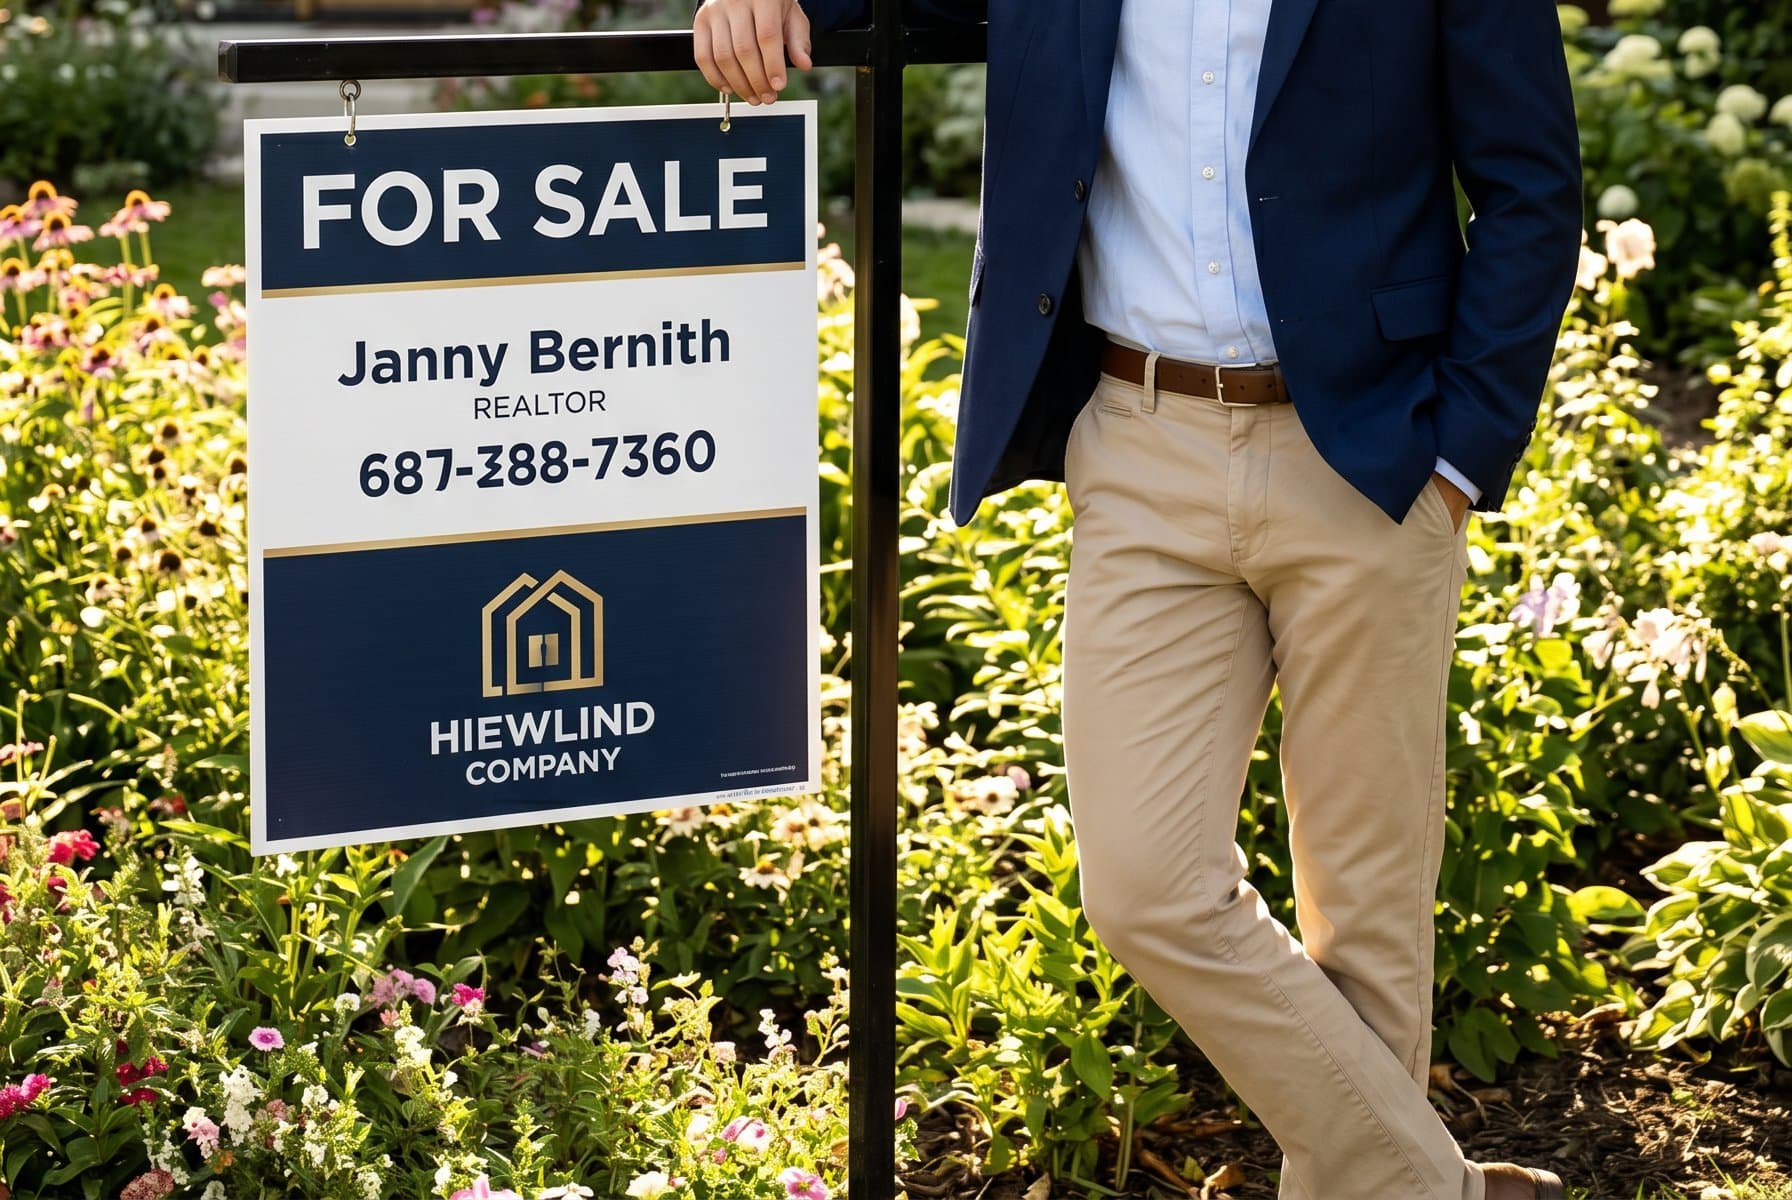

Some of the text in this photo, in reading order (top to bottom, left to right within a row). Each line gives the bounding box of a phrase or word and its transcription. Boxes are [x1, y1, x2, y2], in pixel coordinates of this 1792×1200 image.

[302, 156, 768, 250] FOR SALE
[337, 318, 730, 388] Janny Bernith
[474, 390, 606, 420] REALTOR
[430, 701, 655, 755] HIEWLIND
[465, 746, 622, 786] COMPANY
